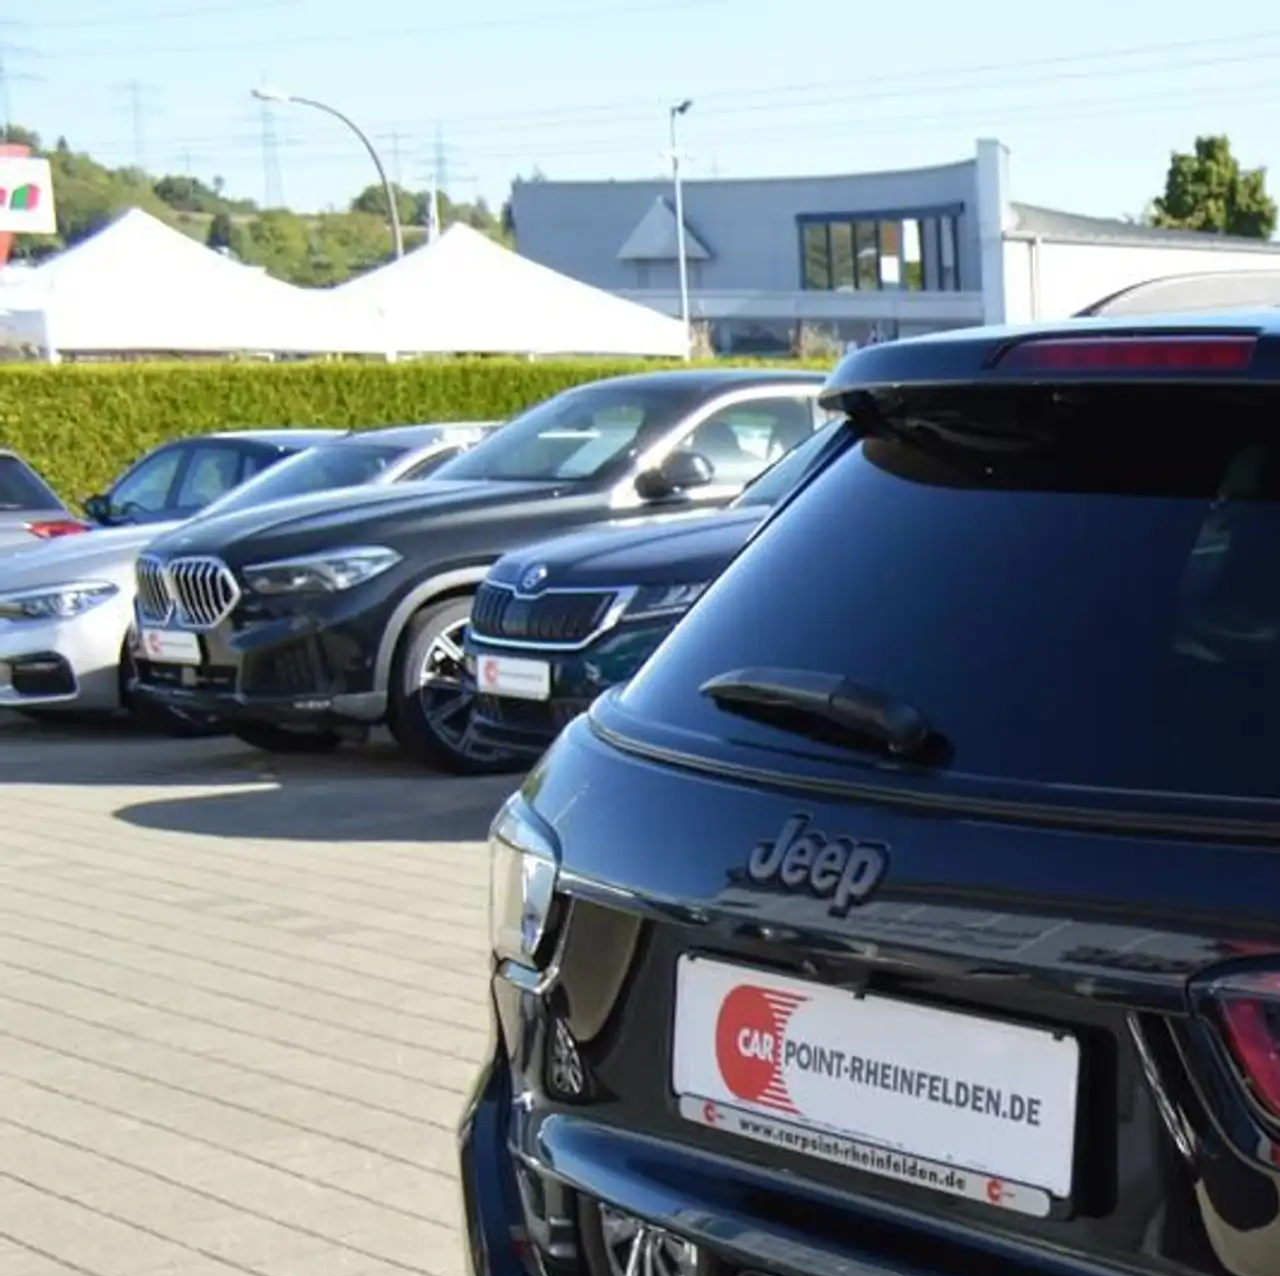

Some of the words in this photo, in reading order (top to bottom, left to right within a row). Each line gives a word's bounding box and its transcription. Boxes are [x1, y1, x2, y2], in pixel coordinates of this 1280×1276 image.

[749, 812, 890, 918] Jeep
[736, 1027, 775, 1064] CAR
[784, 1039, 1042, 1126] POINT-RHEINFELDEN.DE
[738, 1117, 967, 1191] www.carpoint-rheinfelden.de
